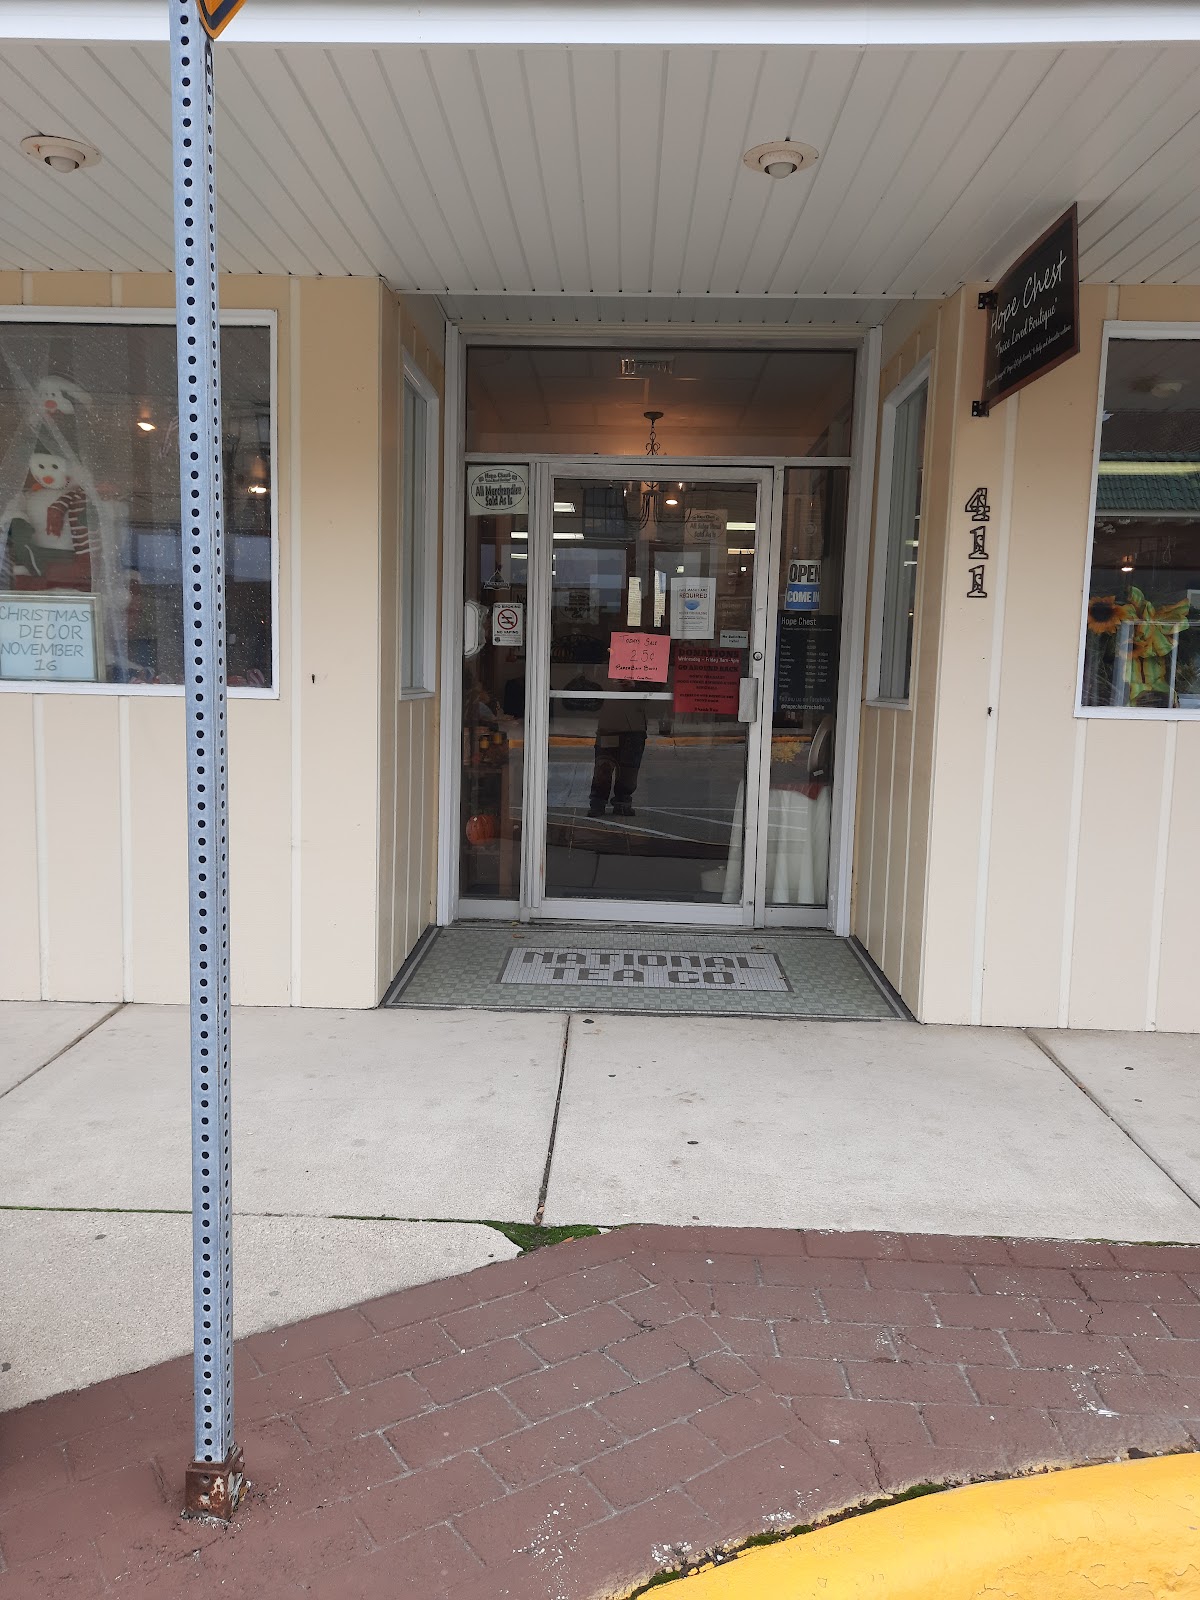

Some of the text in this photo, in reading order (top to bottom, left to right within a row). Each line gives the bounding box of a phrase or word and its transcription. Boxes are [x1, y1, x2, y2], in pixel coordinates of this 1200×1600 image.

[990, 249, 1067, 338] Hope Chest
[476, 486, 485, 497] All
[485, 495, 513, 506] Sold As Is
[964, 487, 991, 599] 411
[789, 563, 821, 583] OPEN
[787, 590, 820, 603] COME IN
[0, 605, 91, 622] CHRISTMAS
[781, 616, 816, 627] Hope Chest
[19, 623, 83, 640] DECOR
[0, 641, 84, 657] NOVEMBER
[678, 649, 740, 658] DONATIONS
[33, 658, 58, 671] 16
[705, 656, 719, 664] Friday
[689, 664, 719, 672] AROUND
[719, 665, 739, 673] BACK
[521, 951, 765, 969] NATIONAL
[545, 966, 645, 983] TEA
